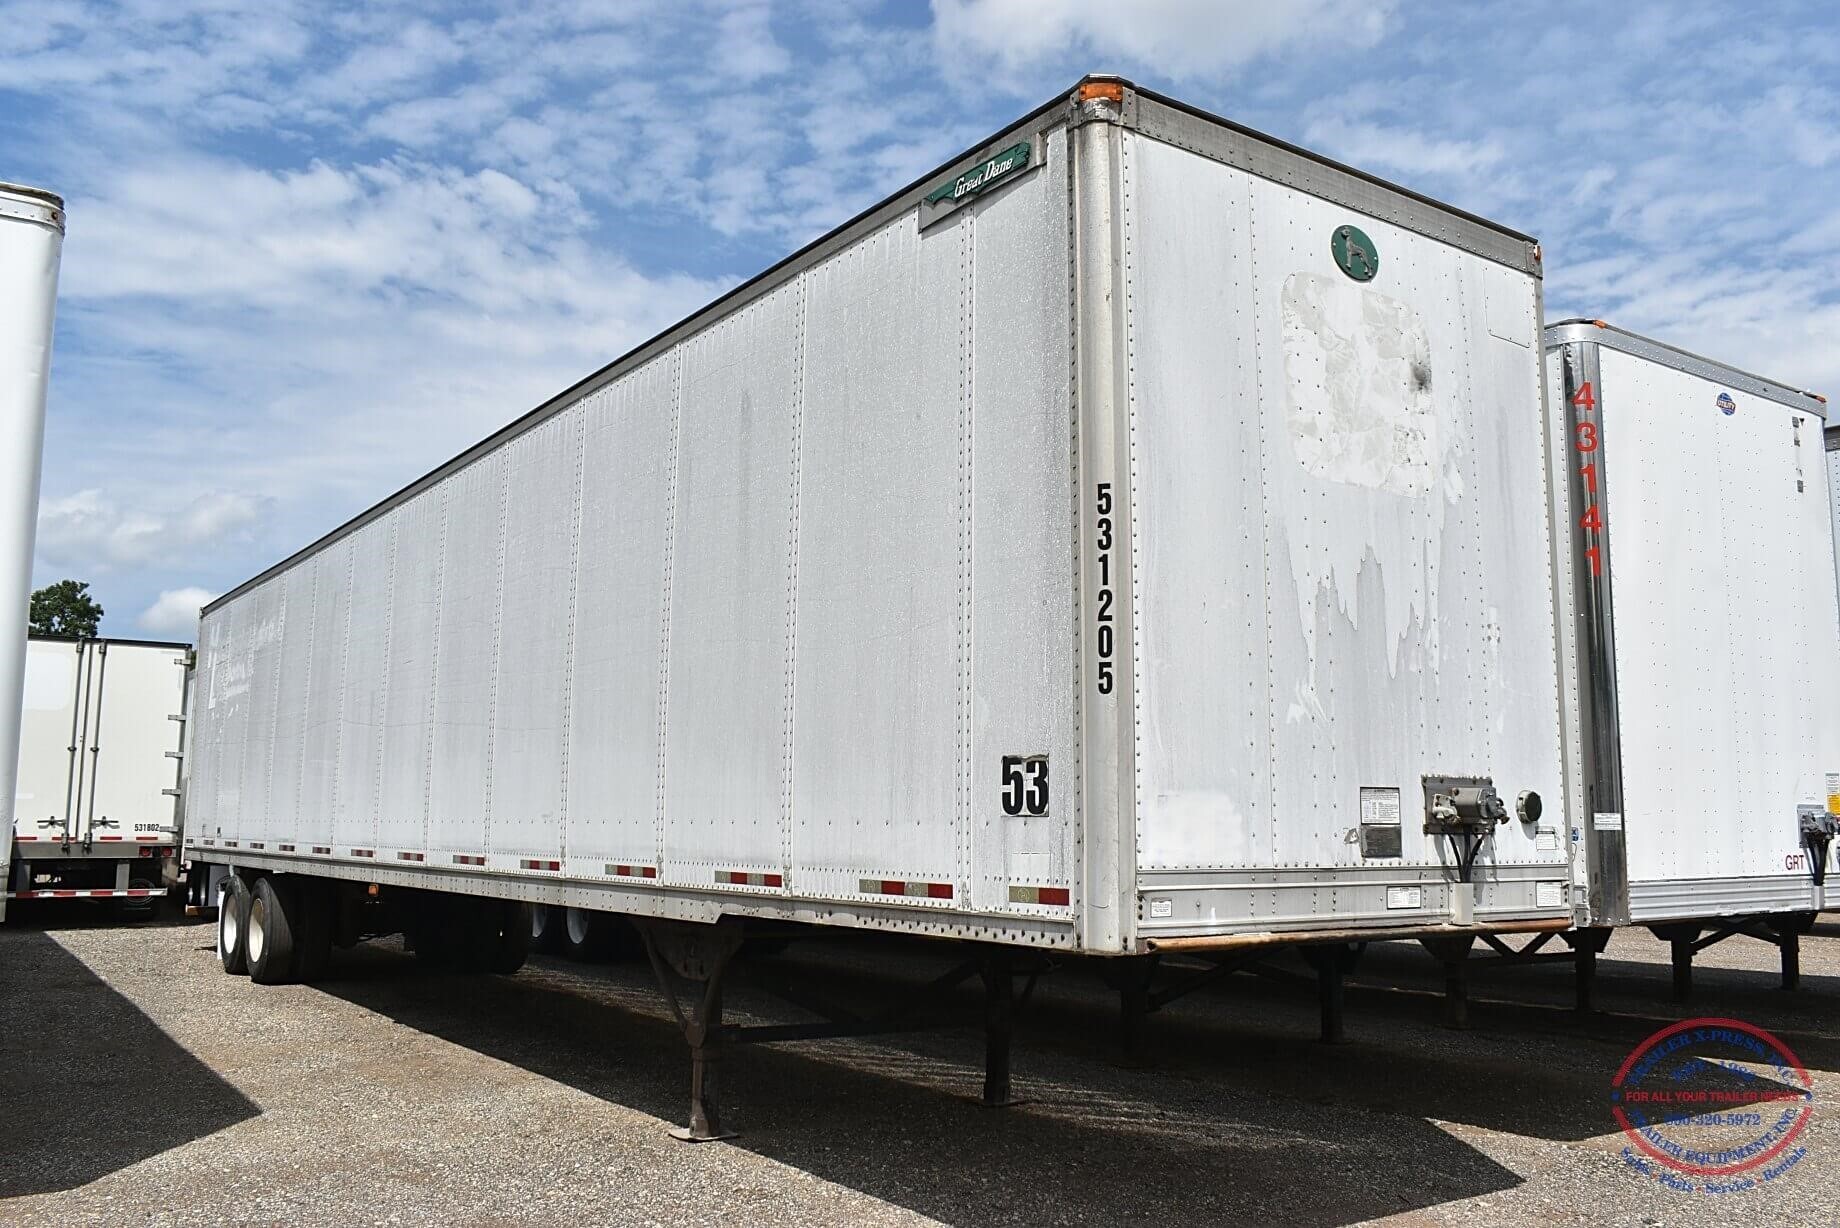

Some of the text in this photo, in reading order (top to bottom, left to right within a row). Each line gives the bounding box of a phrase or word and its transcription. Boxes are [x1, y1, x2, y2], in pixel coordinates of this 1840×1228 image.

[954, 158, 1013, 198] Great Dane
[1571, 381, 1602, 577] 43141
[1097, 482, 1113, 695] 531205
[1002, 756, 1048, 815] 53
[135, 824, 159, 832] 531802
[1785, 854, 1805, 871] GRT
